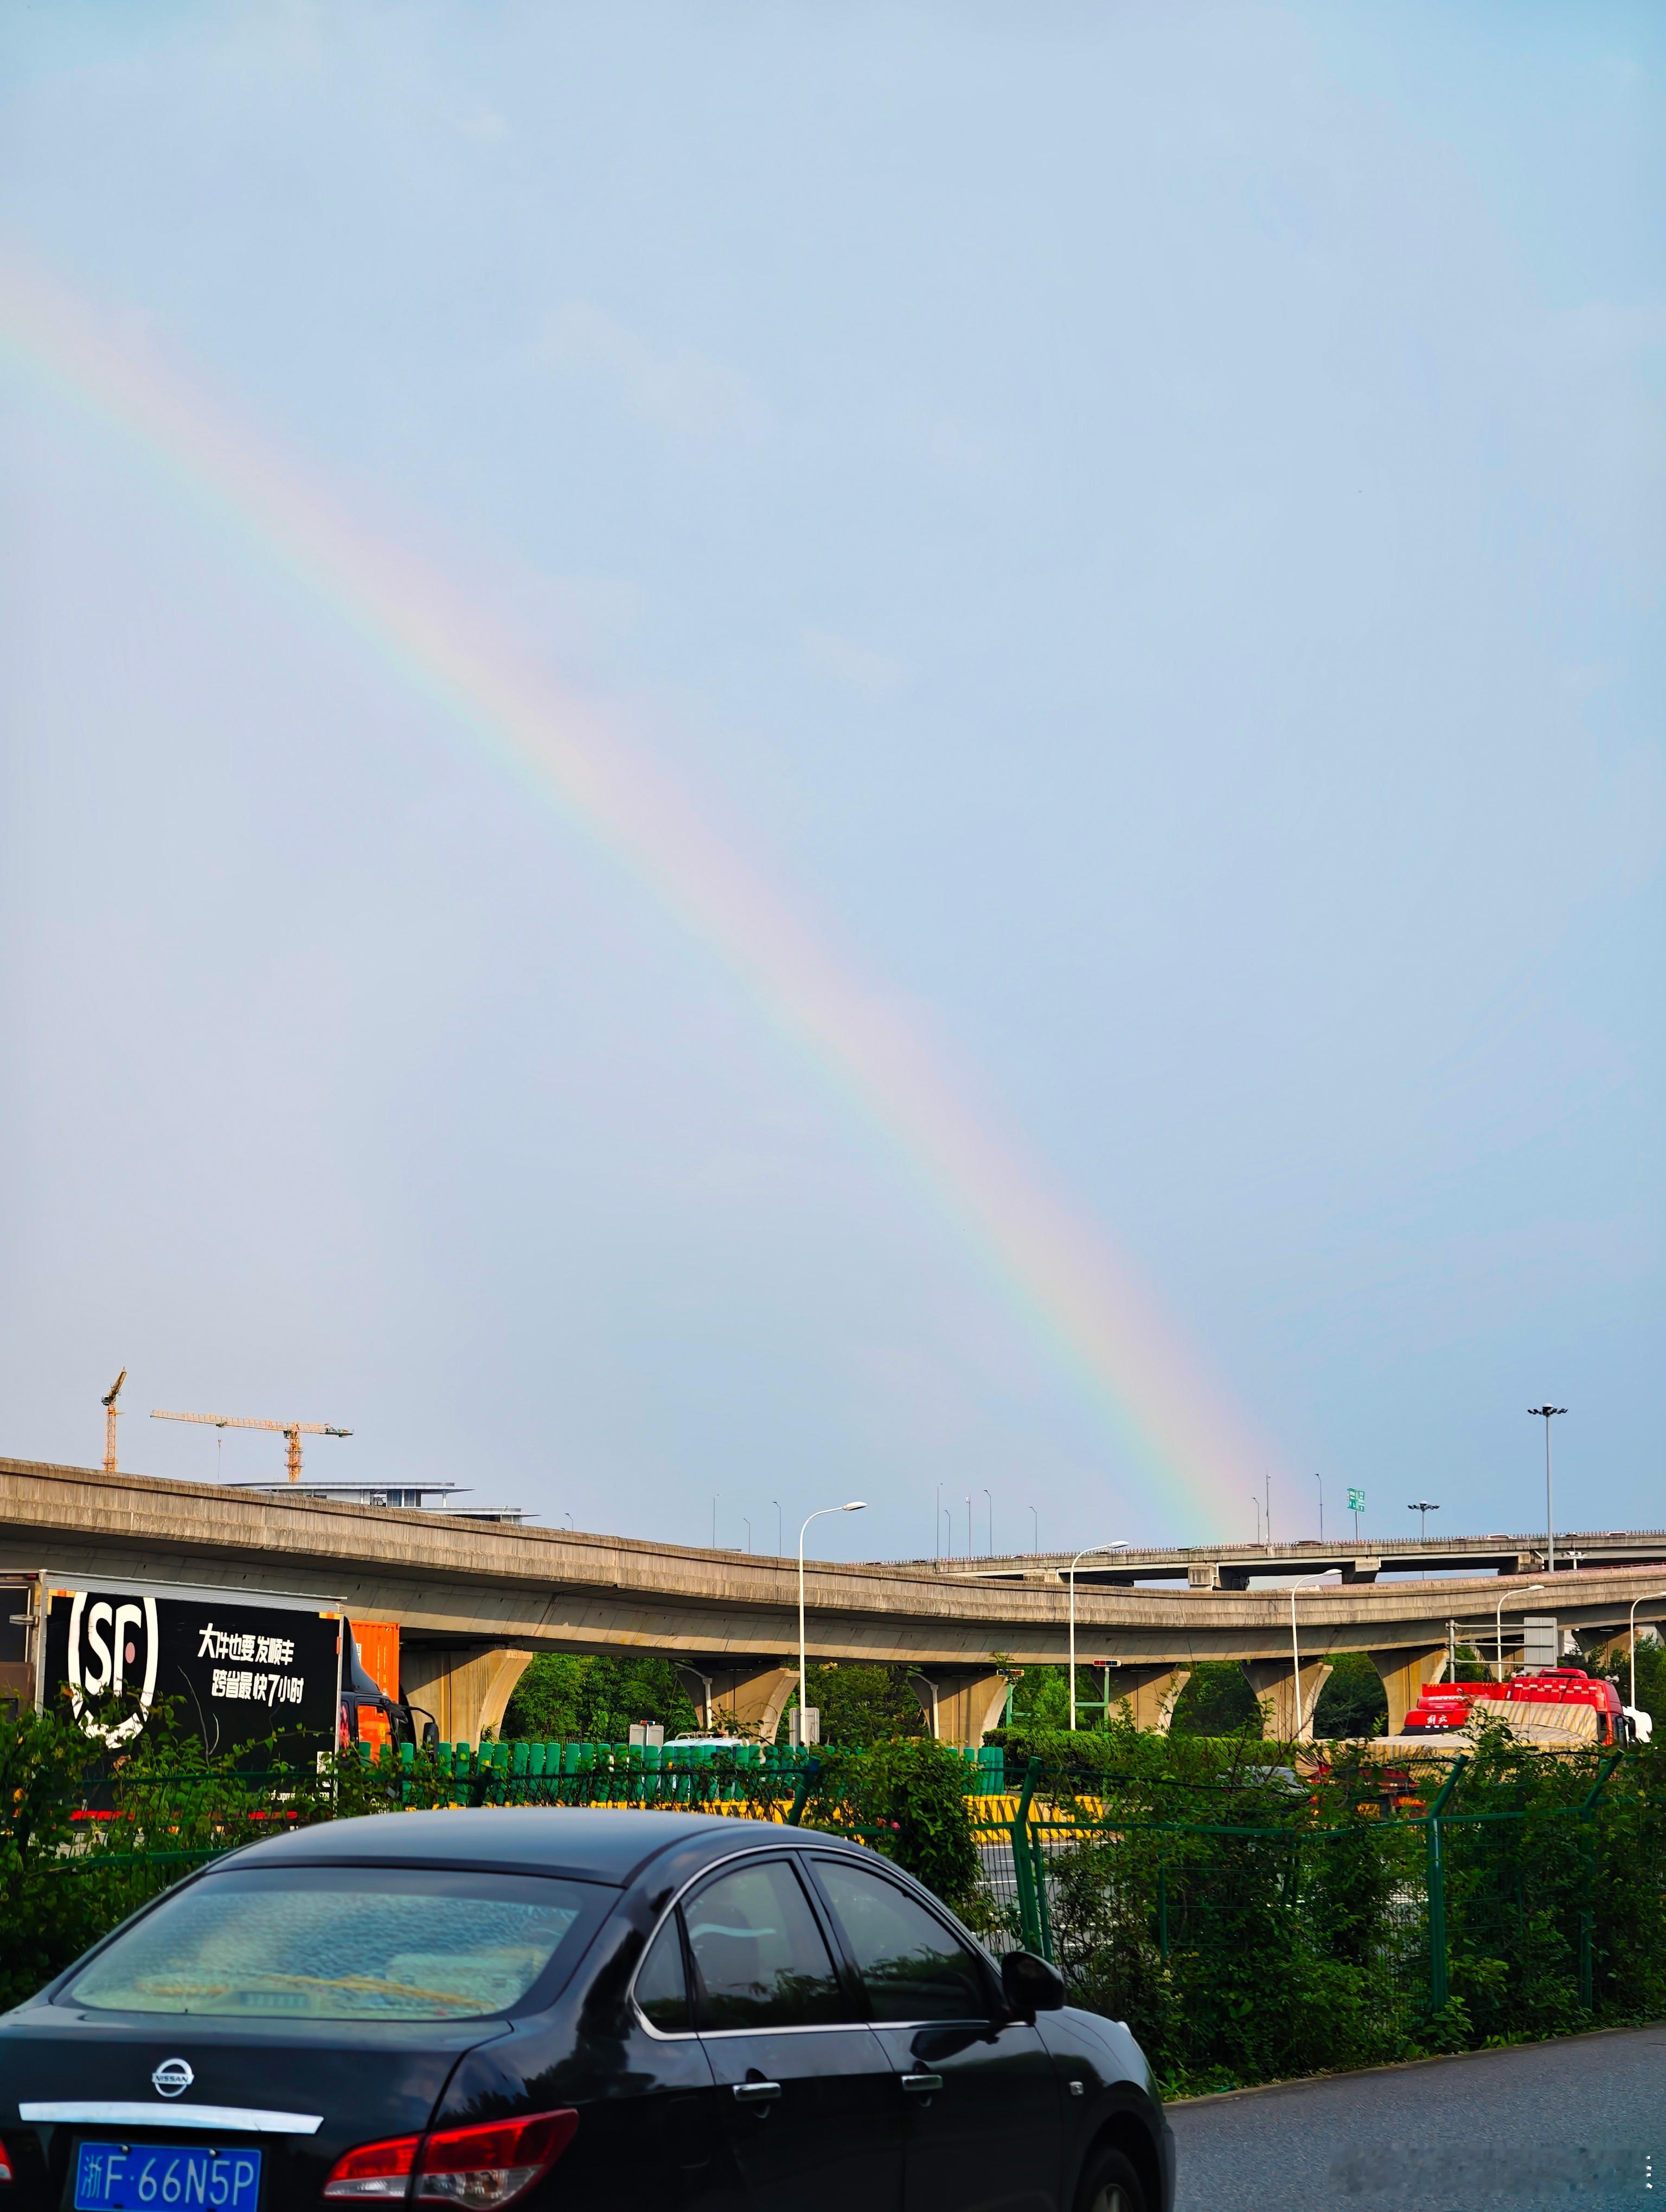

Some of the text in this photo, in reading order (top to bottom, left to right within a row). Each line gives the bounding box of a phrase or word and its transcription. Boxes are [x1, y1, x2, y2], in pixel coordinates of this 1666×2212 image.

[197, 1623, 294, 1666] 大件也要发顺丰
[212, 1669, 304, 1707] 跨省最快7小时
